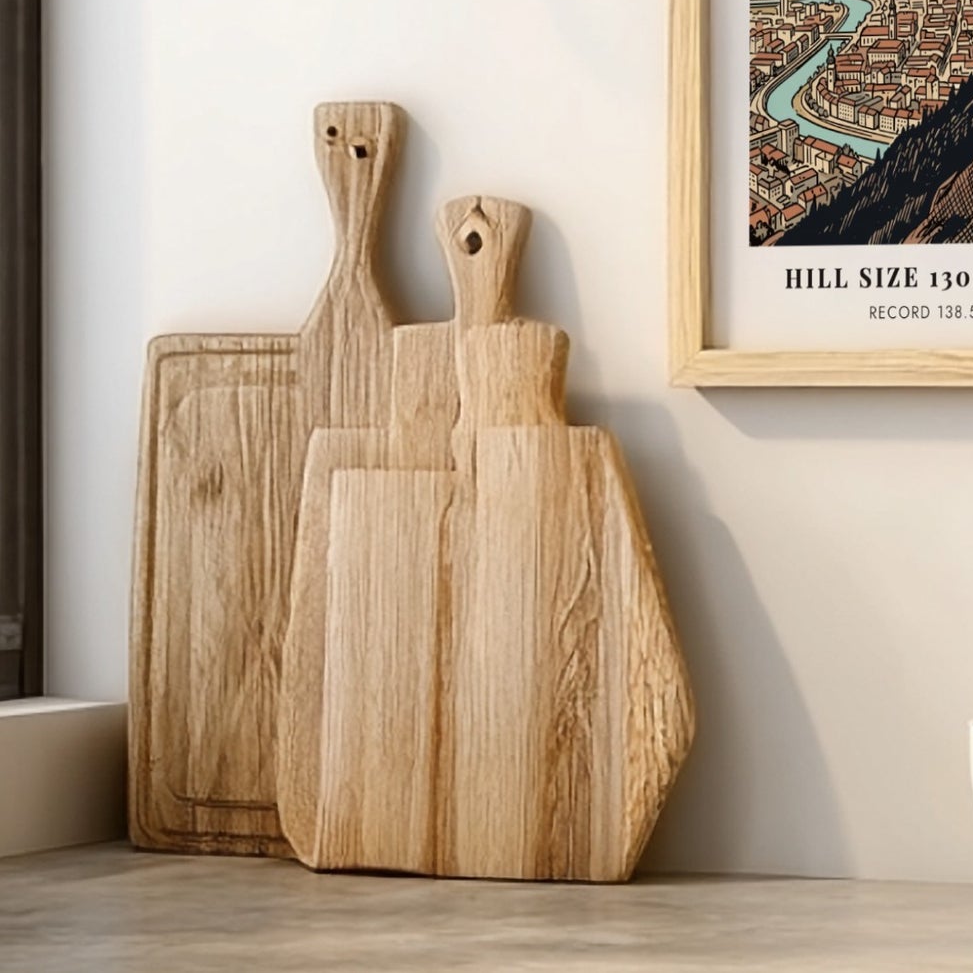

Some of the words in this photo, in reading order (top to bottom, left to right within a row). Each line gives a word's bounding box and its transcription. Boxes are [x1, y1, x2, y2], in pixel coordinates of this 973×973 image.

[785, 267, 849, 290] HILL
[859, 266, 918, 289] SIZE
[929, 270, 971, 292] 130
[869, 305, 931, 320] RECORD
